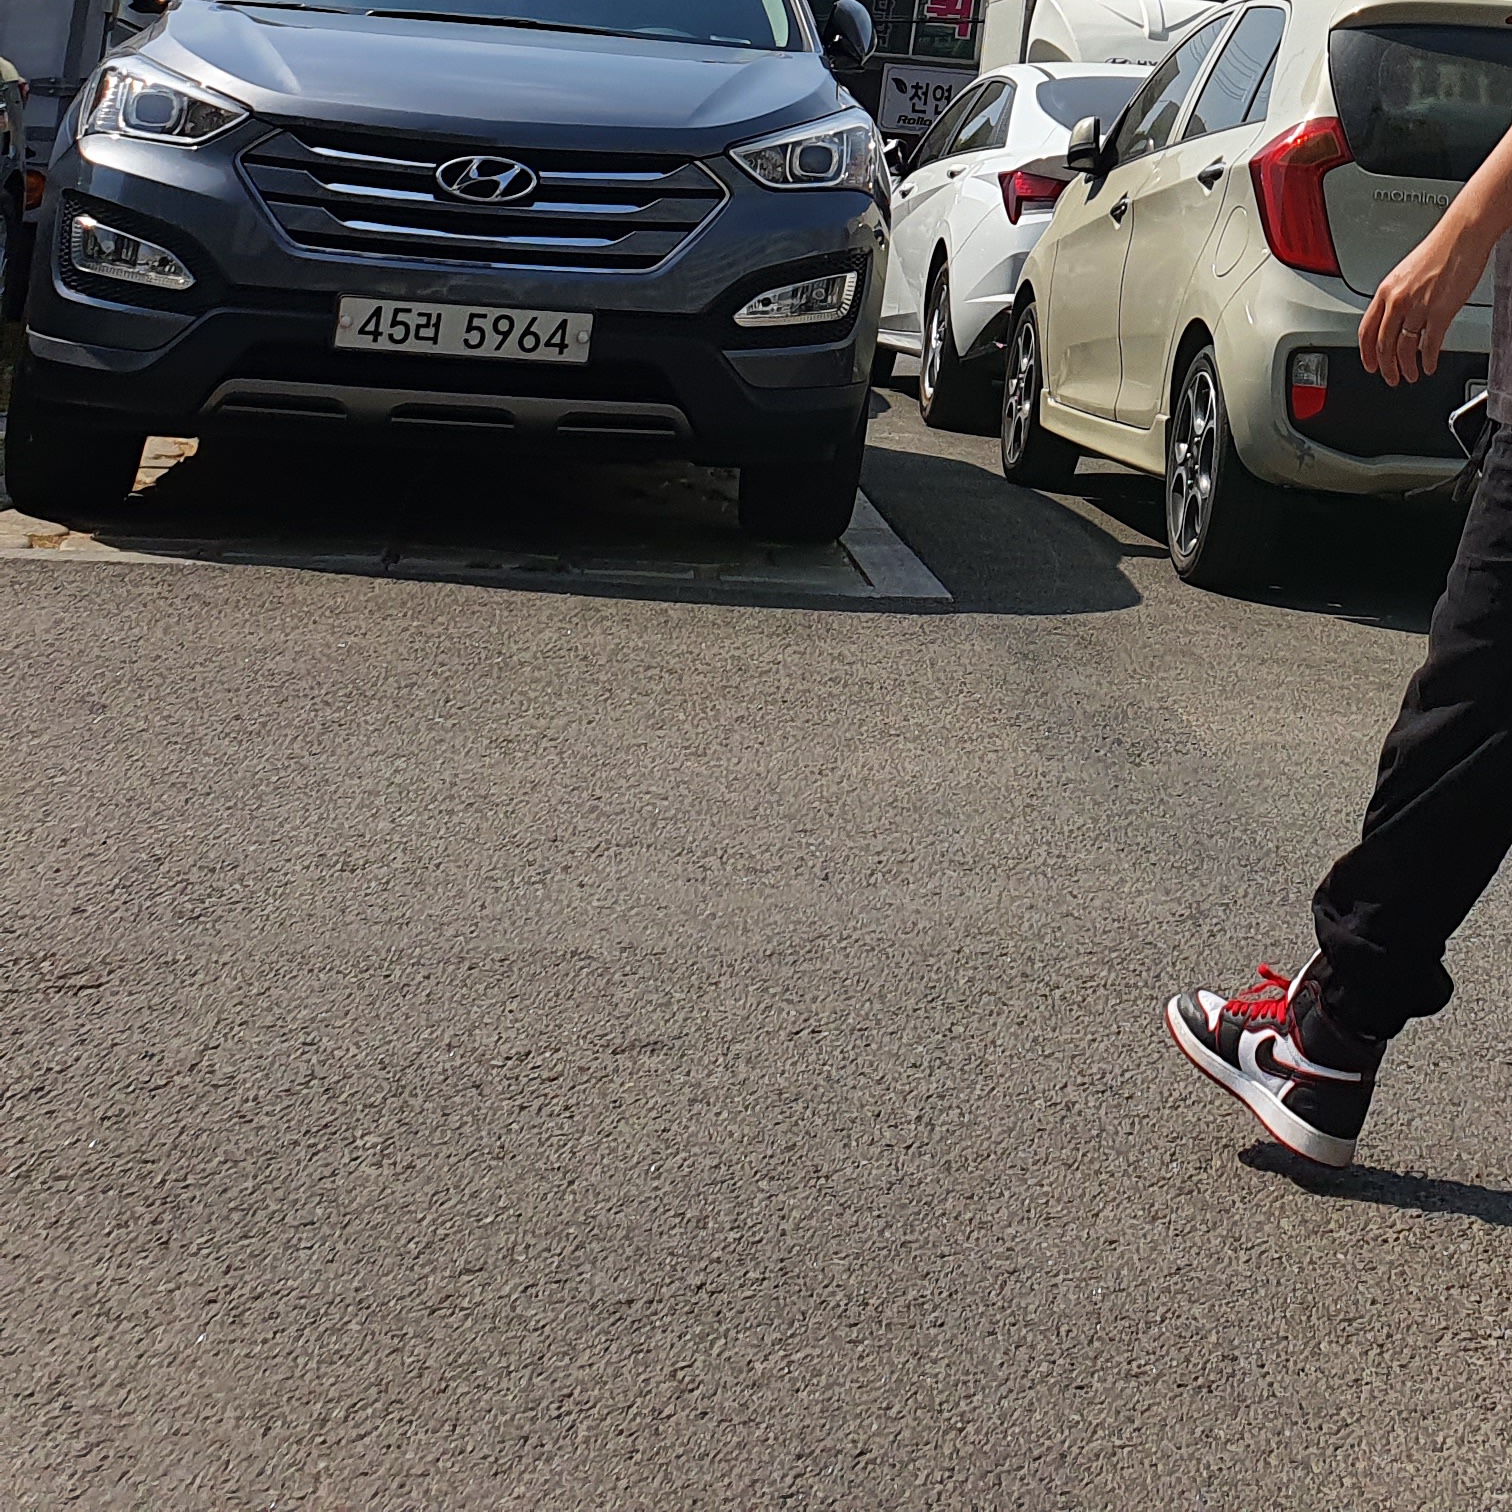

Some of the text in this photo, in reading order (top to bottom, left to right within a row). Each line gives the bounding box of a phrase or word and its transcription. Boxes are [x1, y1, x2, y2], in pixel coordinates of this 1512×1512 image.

[1374, 189, 1449, 208] morning
[357, 305, 570, 356] 45러 5964
